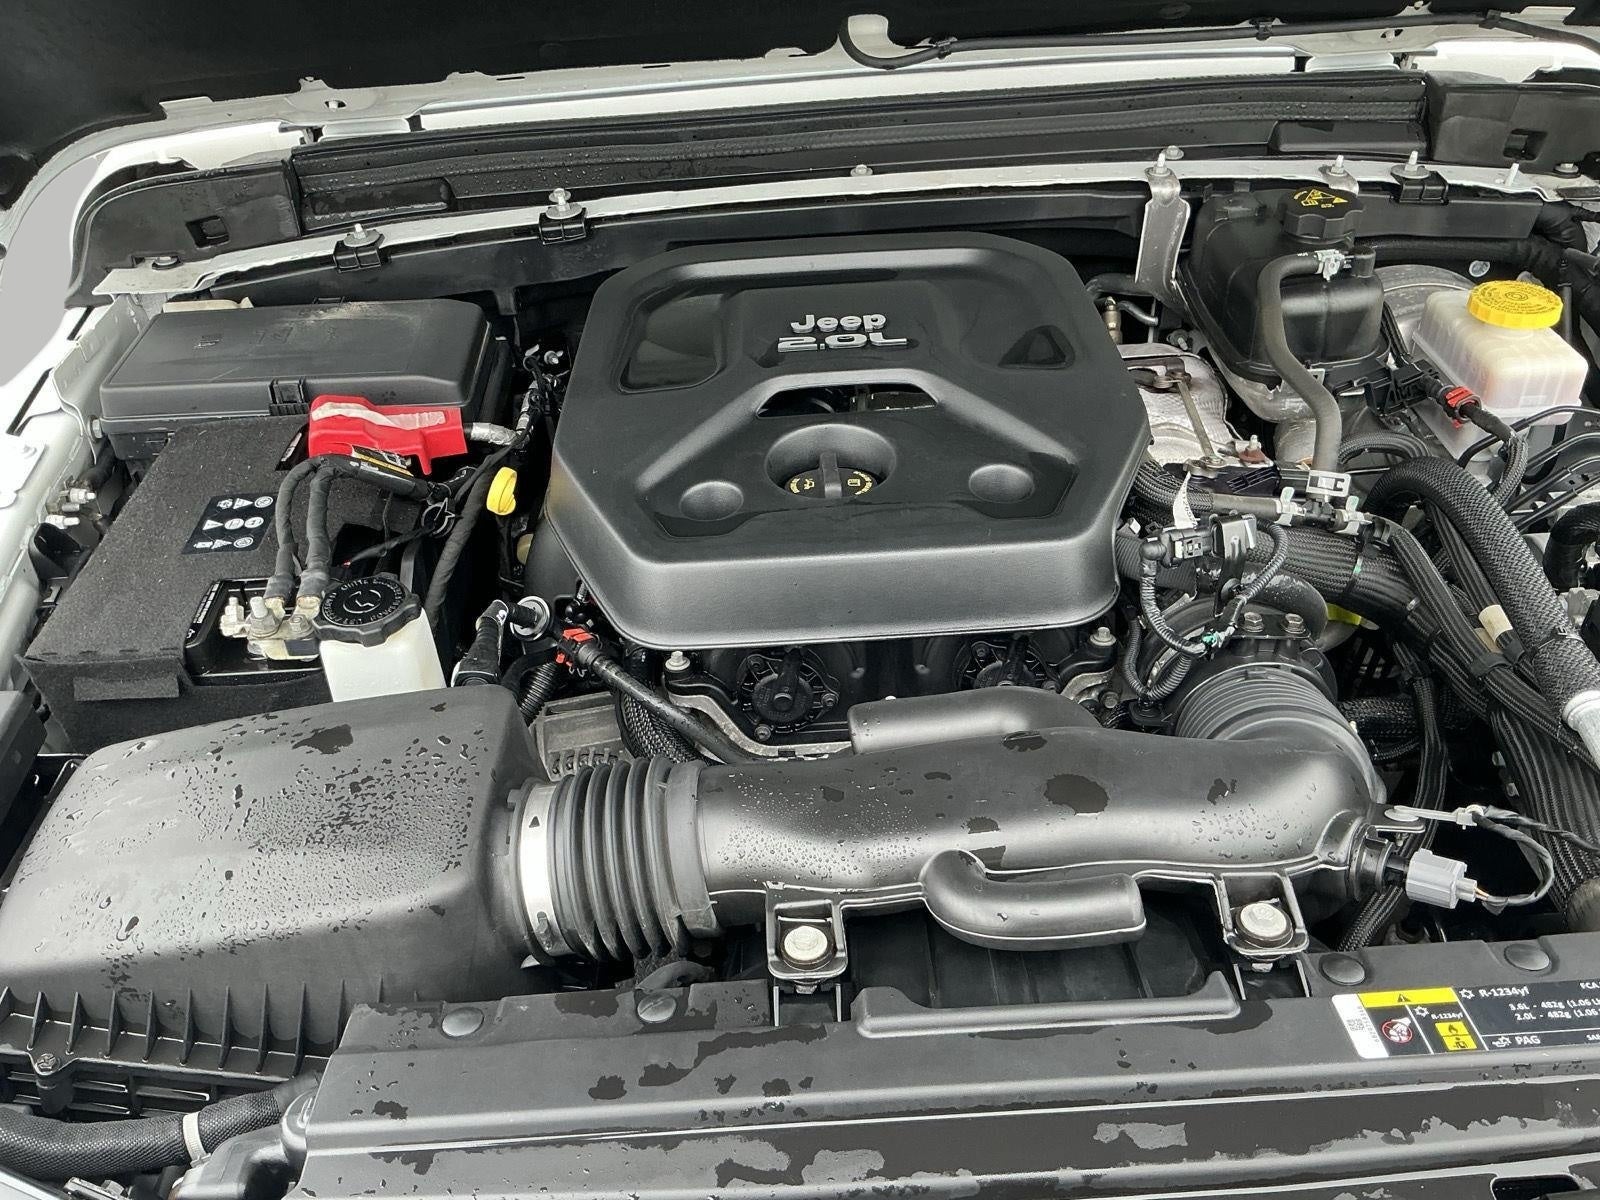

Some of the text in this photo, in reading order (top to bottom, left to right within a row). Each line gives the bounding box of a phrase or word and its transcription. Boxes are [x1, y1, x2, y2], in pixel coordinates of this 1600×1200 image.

[790, 313, 887, 334] Jeep
[777, 332, 908, 353] 2.0L
[1478, 986, 1530, 997] R-1234yf
[1540, 1001, 1565, 1009] 482g
[1566, 999, 1592, 1008] (1.06
[1514, 1012, 1537, 1021] 2.0L
[1547, 1010, 1572, 1019] 482g
[1514, 1035, 1541, 1045] PAG
